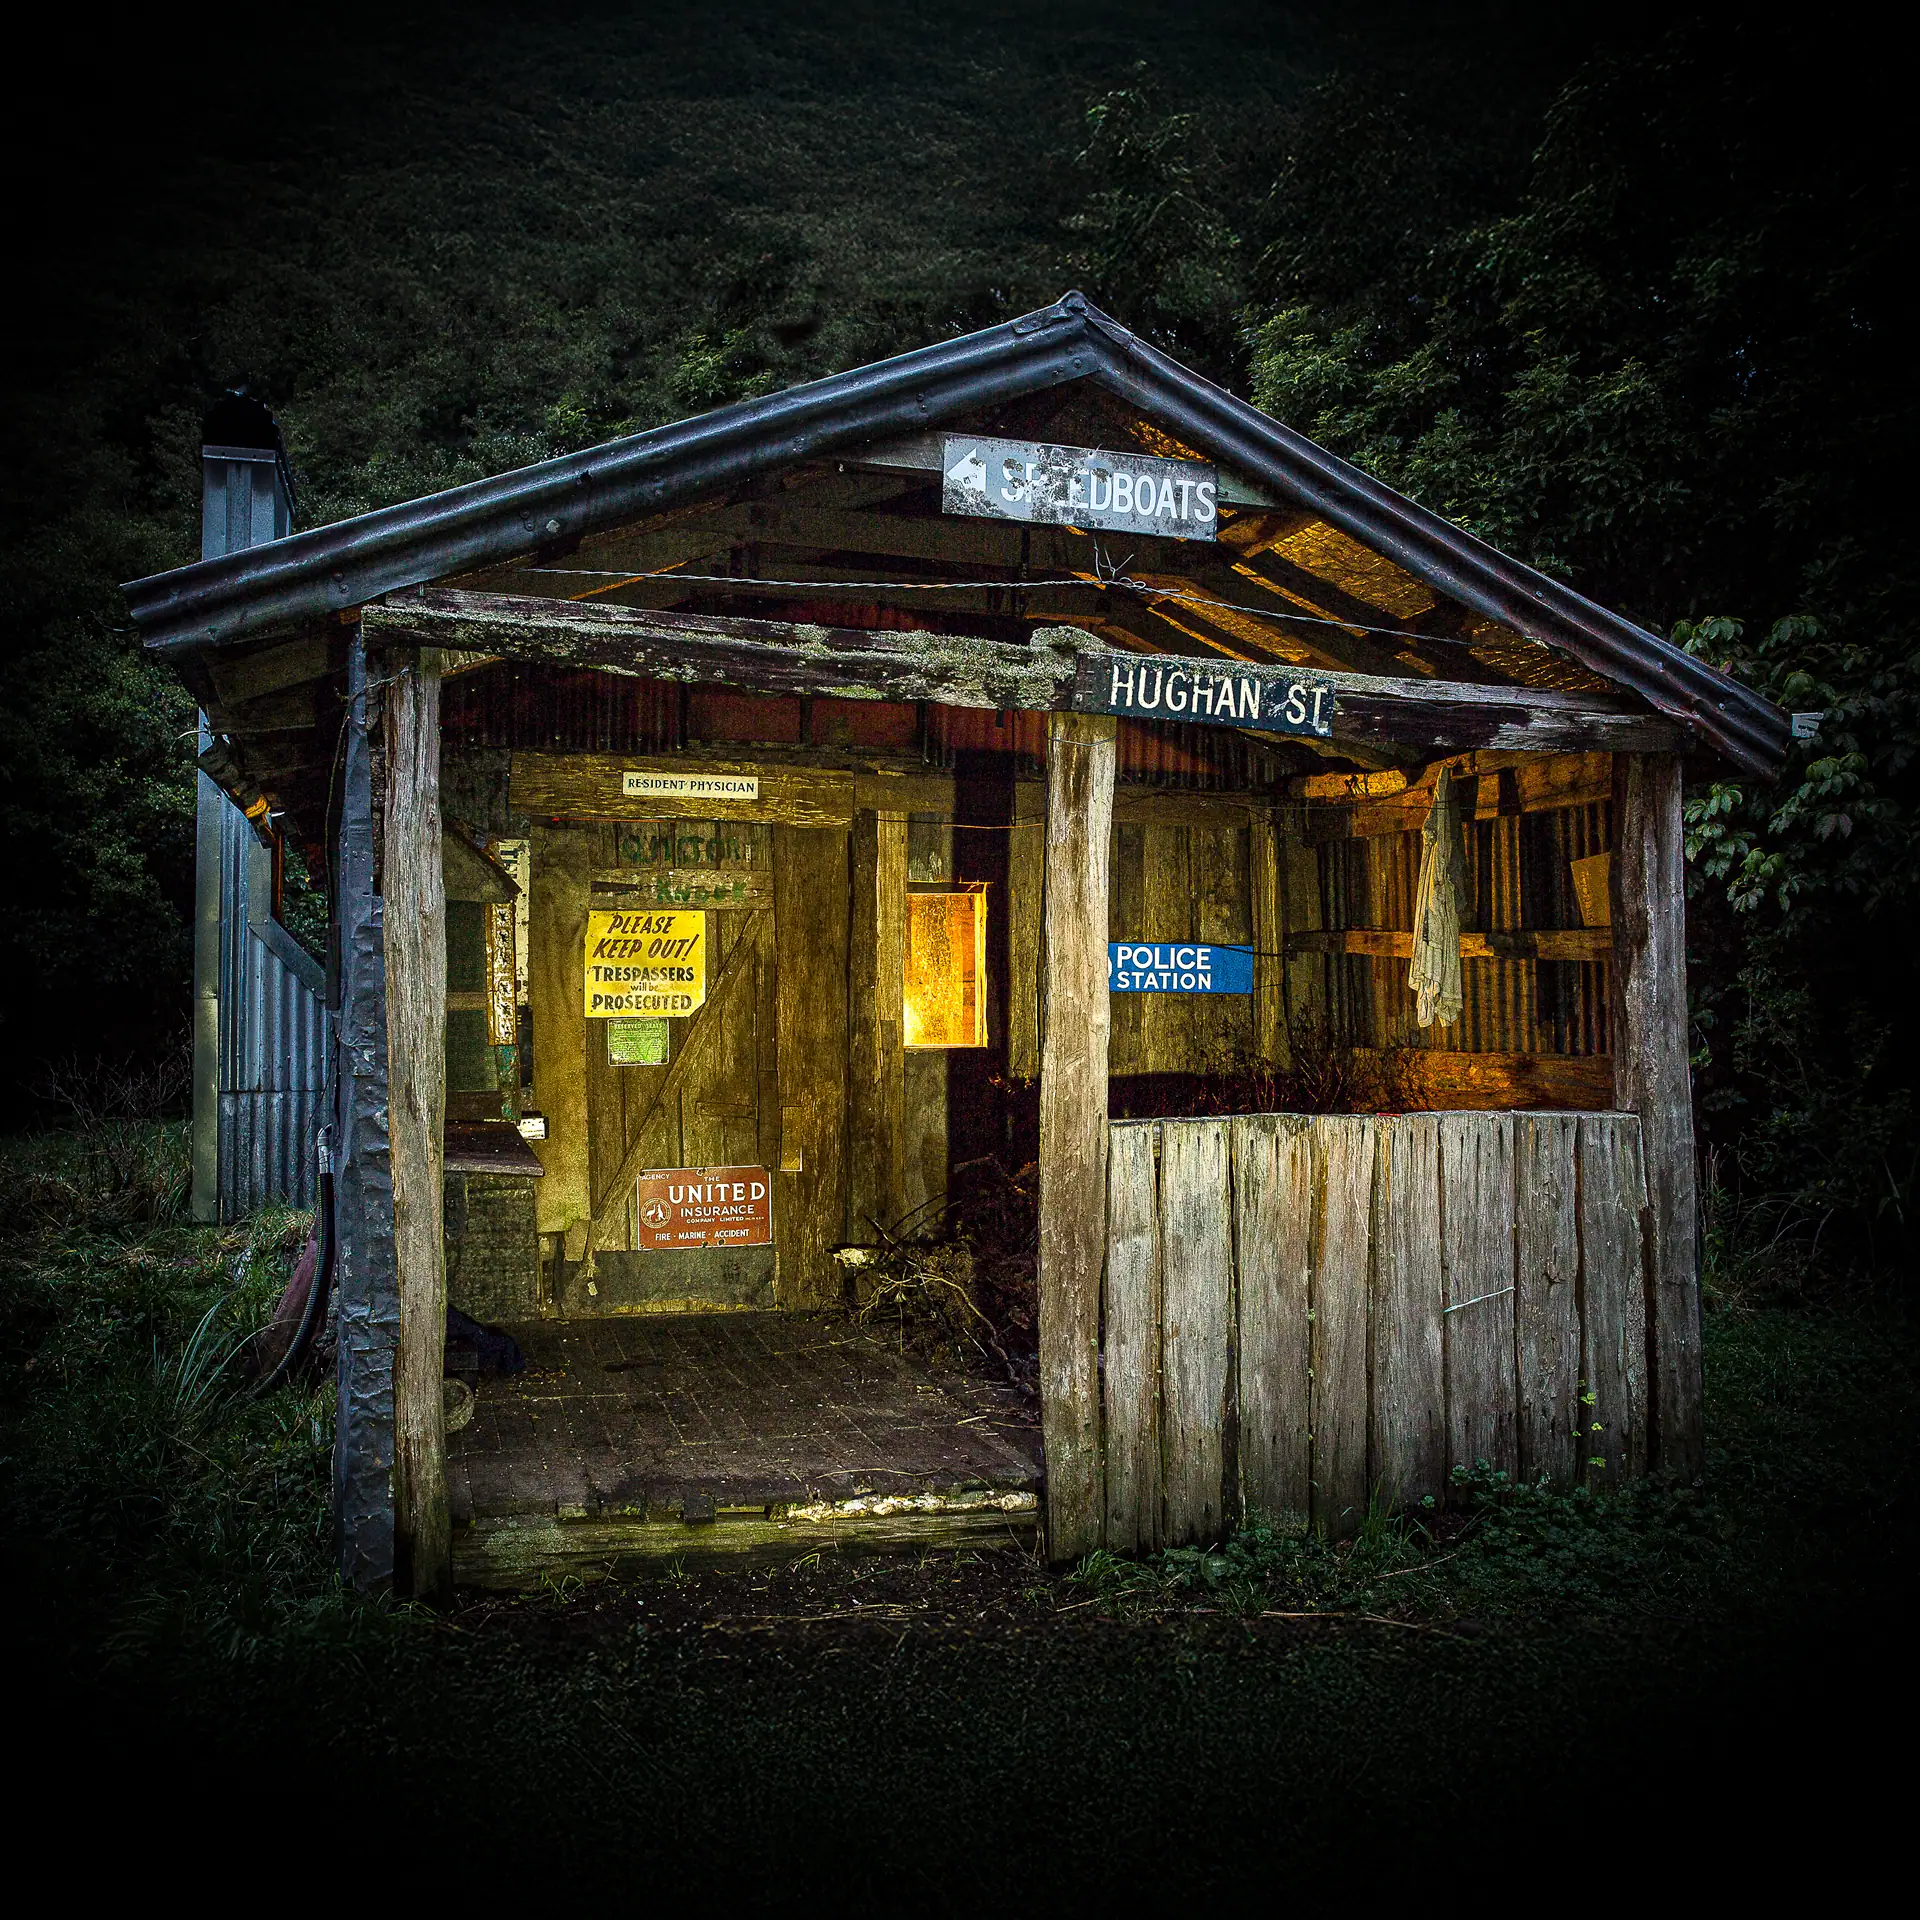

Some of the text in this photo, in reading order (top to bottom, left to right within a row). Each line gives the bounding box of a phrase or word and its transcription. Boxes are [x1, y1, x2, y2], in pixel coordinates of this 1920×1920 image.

[1110, 665, 1329, 727] HUGHAN ST
[628, 778, 755, 793] RESIDENT PHYSICIAN
[607, 914, 677, 935] PLEASE
[592, 933, 700, 962] KEEP OUT!
[1117, 946, 1211, 970] POLICE
[592, 965, 695, 982] TRESPASSERS
[1117, 971, 1211, 990] STATION
[630, 981, 647, 991] will
[592, 993, 692, 1010] PROSECUTED
[641, 1173, 670, 1181] AGENCY
[668, 1182, 765, 1204] UNITED
[681, 1204, 755, 1218] INSURANCE
[655, 1228, 750, 1241] FIRE MARINE ACCIDENT
